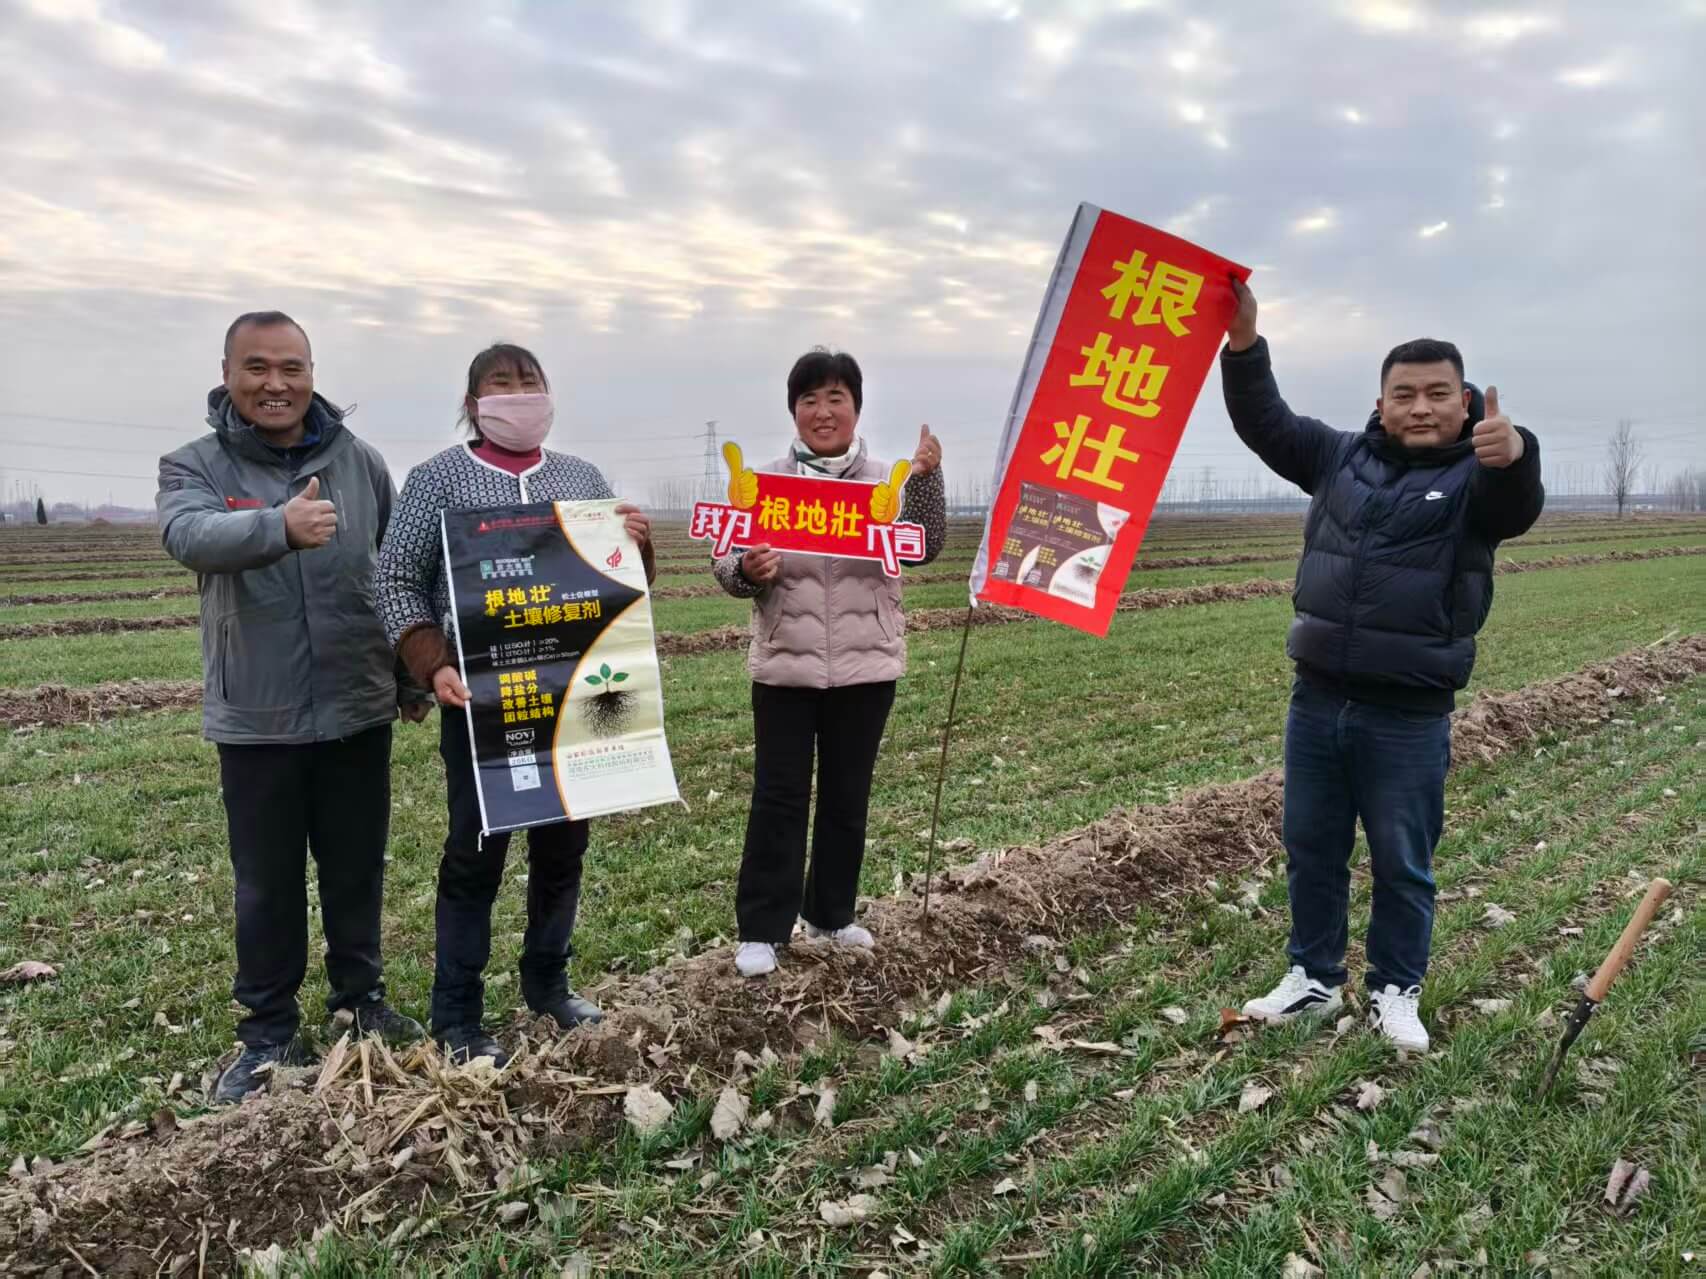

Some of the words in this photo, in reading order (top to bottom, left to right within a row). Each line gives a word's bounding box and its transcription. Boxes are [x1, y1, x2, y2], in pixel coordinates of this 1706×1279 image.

[1040, 249, 1205, 492] 根地壮
[694, 505, 753, 554] 我为
[757, 494, 866, 540] 根地壮
[485, 585, 552, 617] 根地壮
[503, 599, 601, 629] 土壤修复剂
